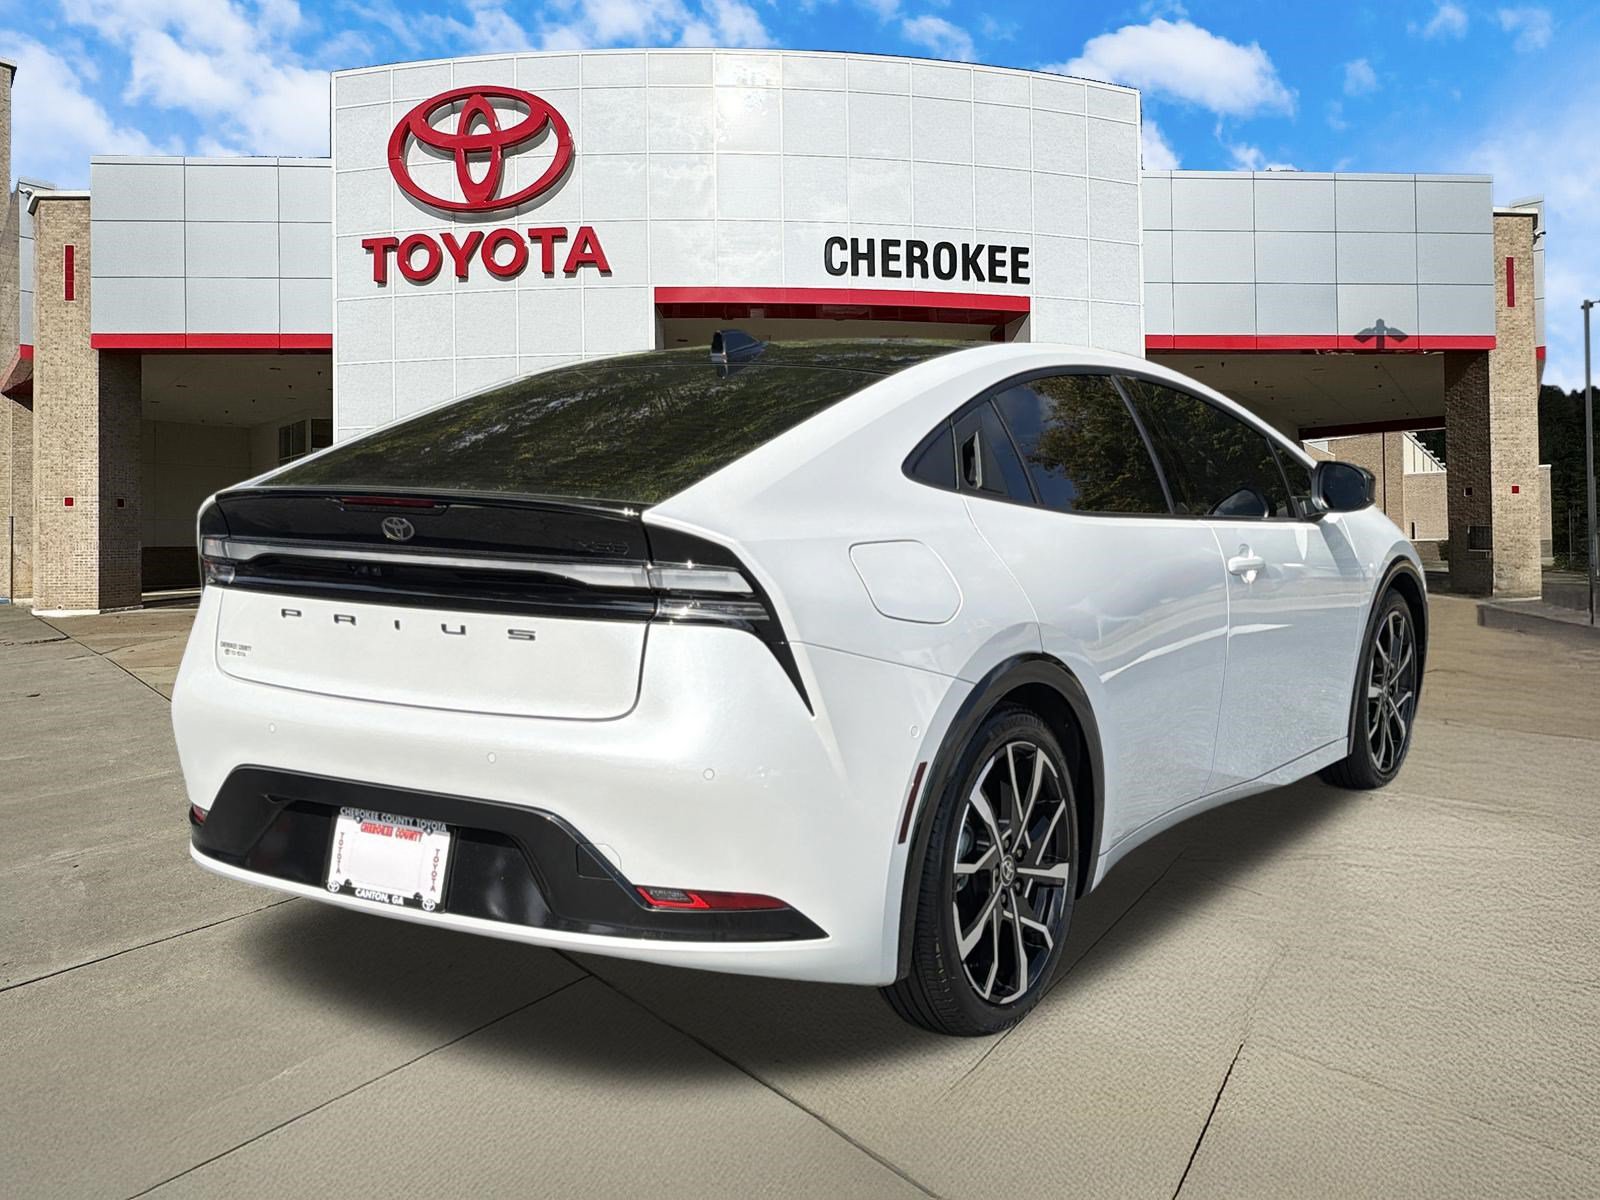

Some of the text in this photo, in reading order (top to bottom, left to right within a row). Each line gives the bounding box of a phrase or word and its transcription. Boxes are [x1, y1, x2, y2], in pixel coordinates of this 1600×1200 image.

[362, 226, 612, 286] TOYOTA
[824, 236, 1031, 285] CHEROKEE
[281, 608, 536, 641] PRIUS
[340, 806, 447, 833] CHEROKEE COUNTY TOYOTA
[335, 831, 345, 874] TOYOTA
[430, 848, 441, 892] TOYOTA
[355, 887, 404, 905] CANTON, GA
